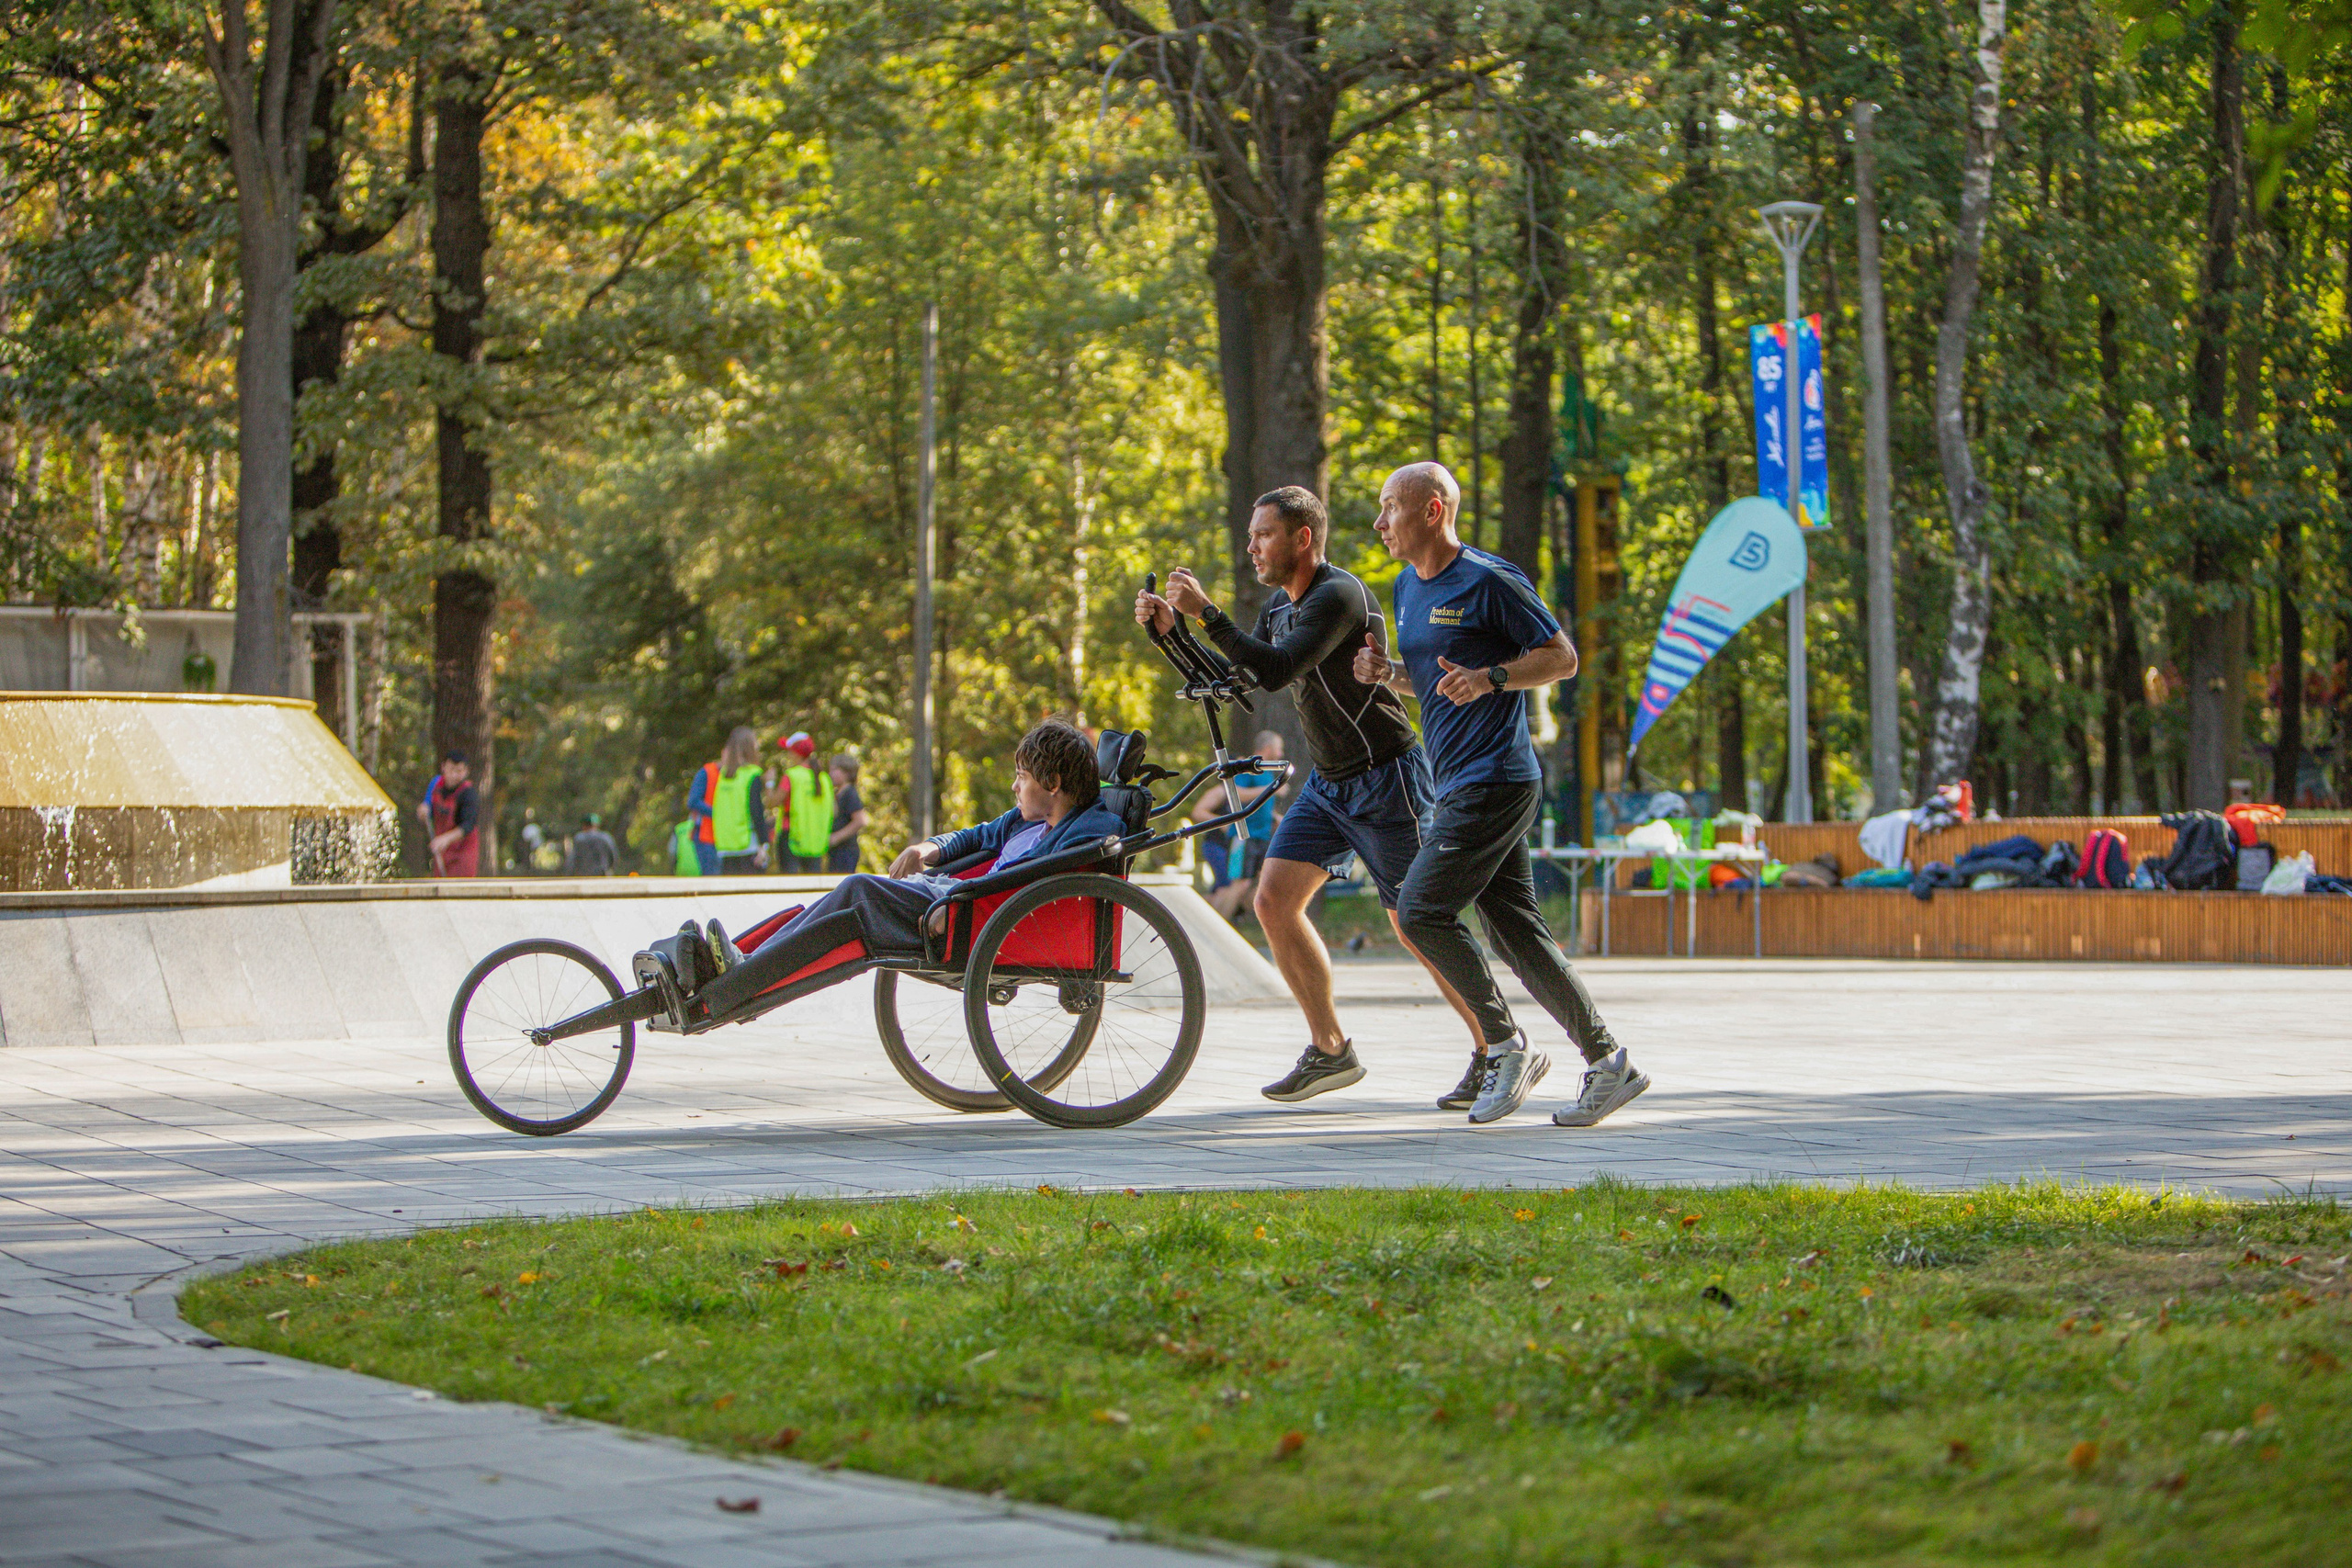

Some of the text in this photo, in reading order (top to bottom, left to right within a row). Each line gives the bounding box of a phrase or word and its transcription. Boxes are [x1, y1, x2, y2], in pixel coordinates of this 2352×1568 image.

[1757, 355, 1782, 381] 85
[1430, 606, 1464, 616] Freedom of
[1429, 615, 1461, 625] Movement
